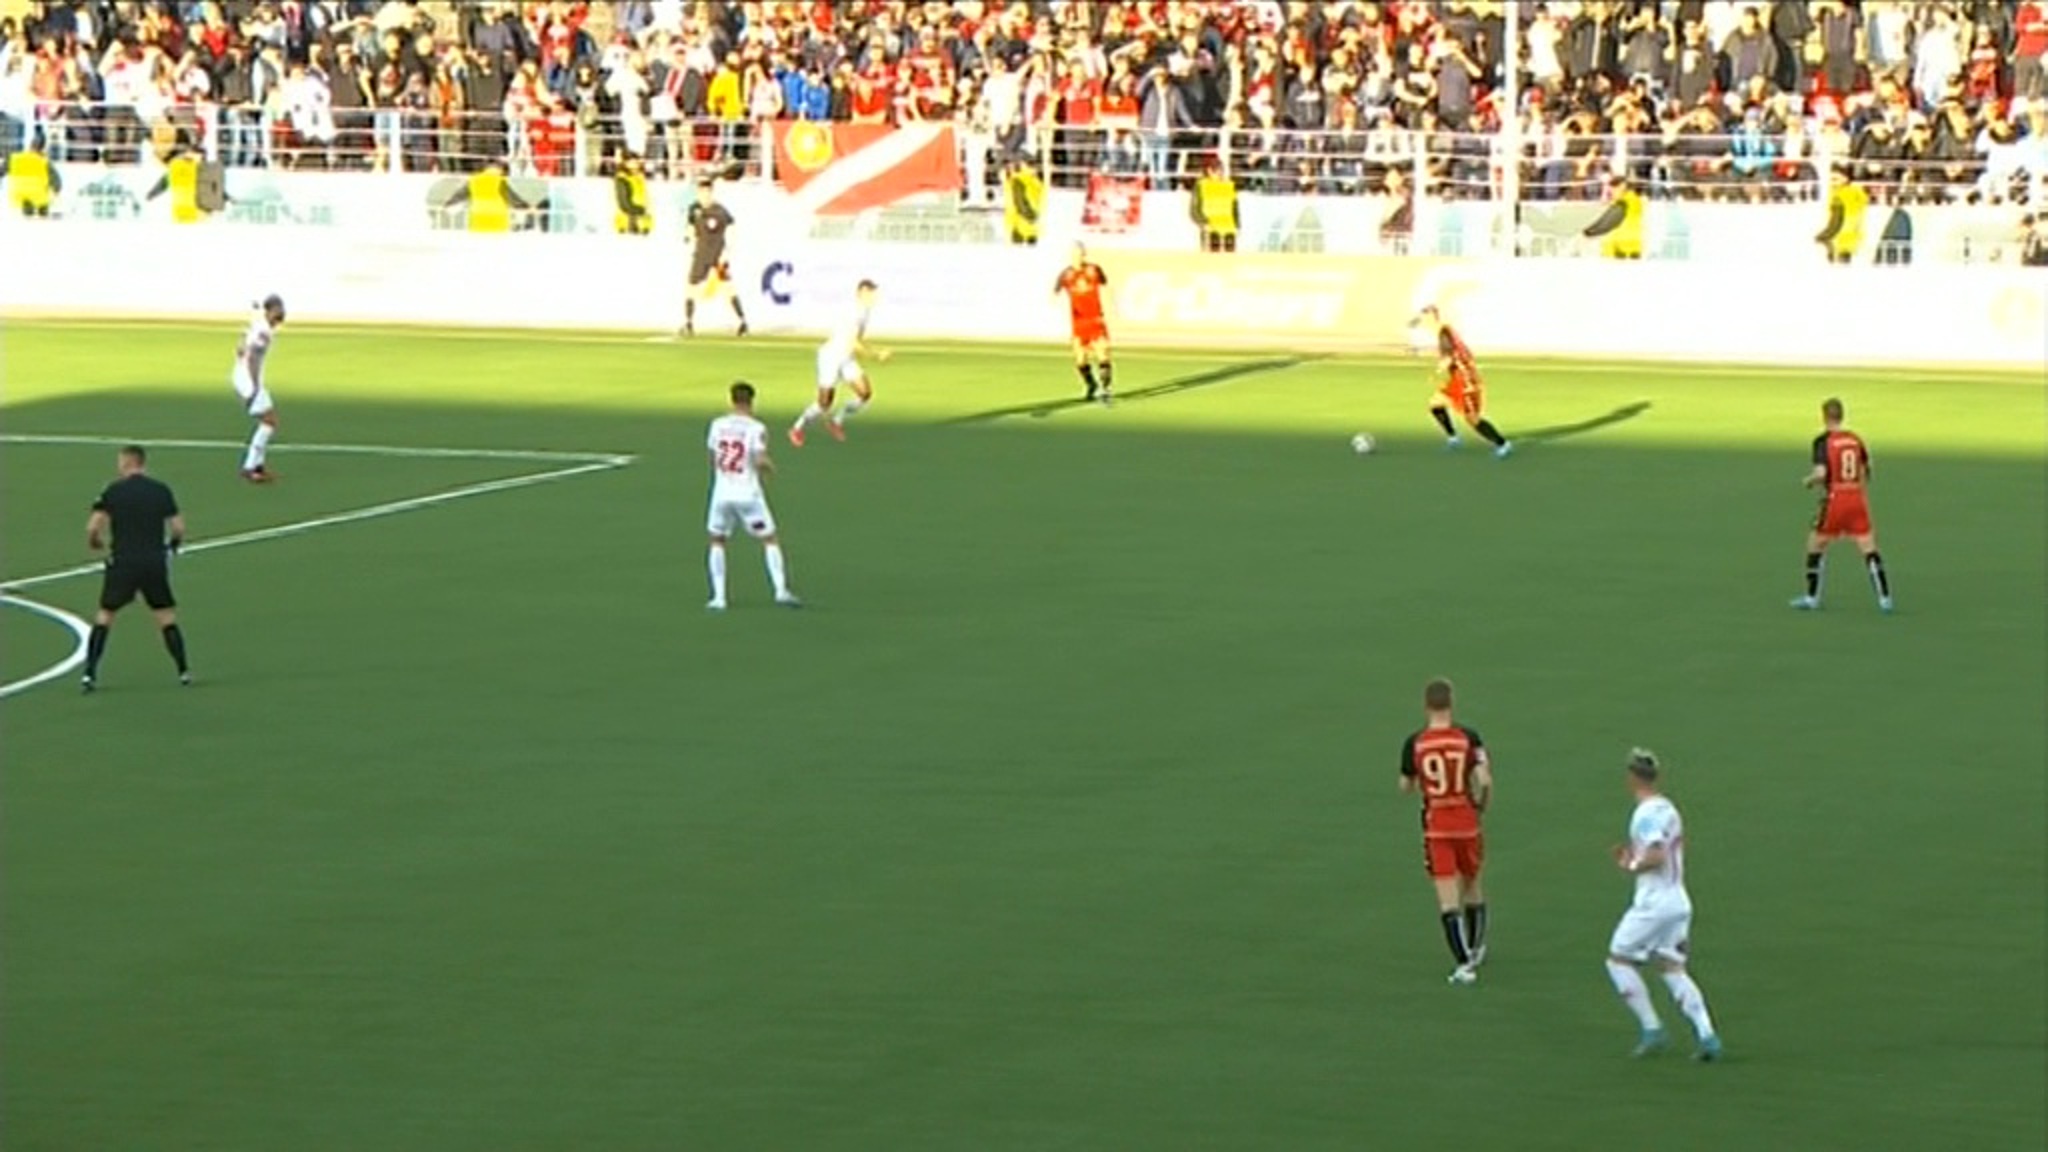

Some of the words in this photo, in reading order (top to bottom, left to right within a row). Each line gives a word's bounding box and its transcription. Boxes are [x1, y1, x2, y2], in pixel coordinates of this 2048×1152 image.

[717, 439, 745, 474] 22
[1840, 447, 1857, 481] 8
[1422, 751, 1467, 796] 97
